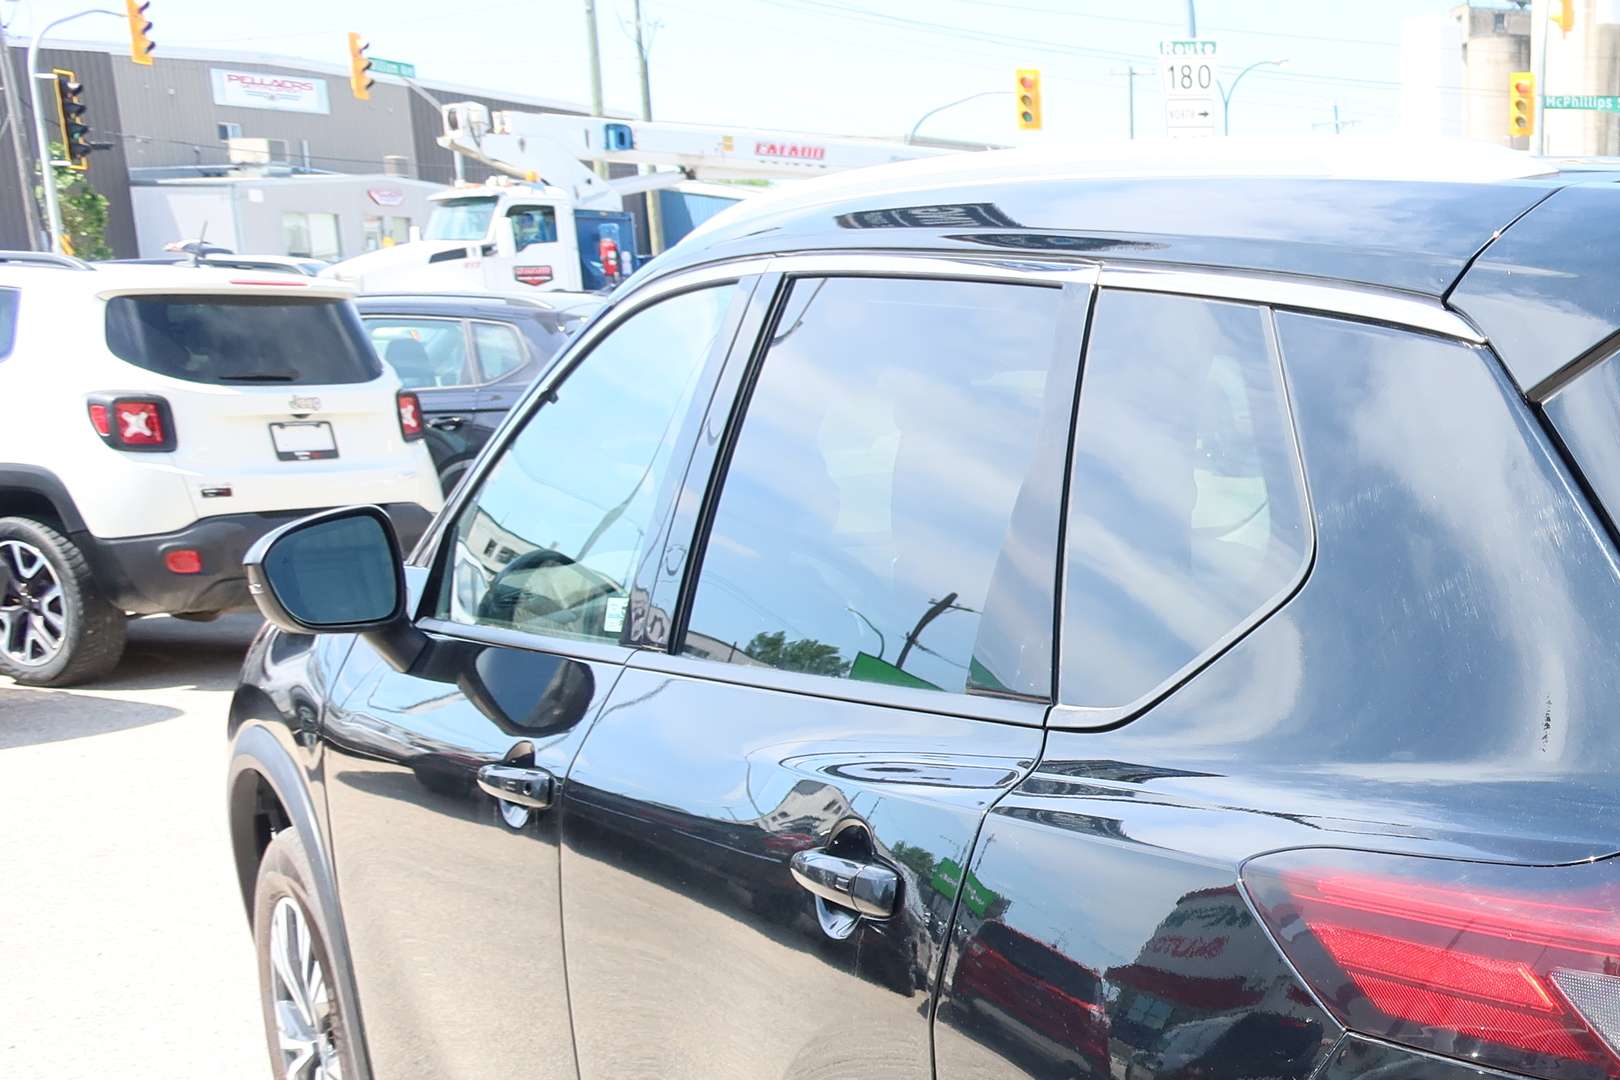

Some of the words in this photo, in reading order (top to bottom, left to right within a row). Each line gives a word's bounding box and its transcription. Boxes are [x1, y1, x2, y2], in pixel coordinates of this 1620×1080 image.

[1162, 41, 1214, 55] Route
[1168, 64, 1211, 89] 180
[1546, 96, 1613, 110] McPhillips
